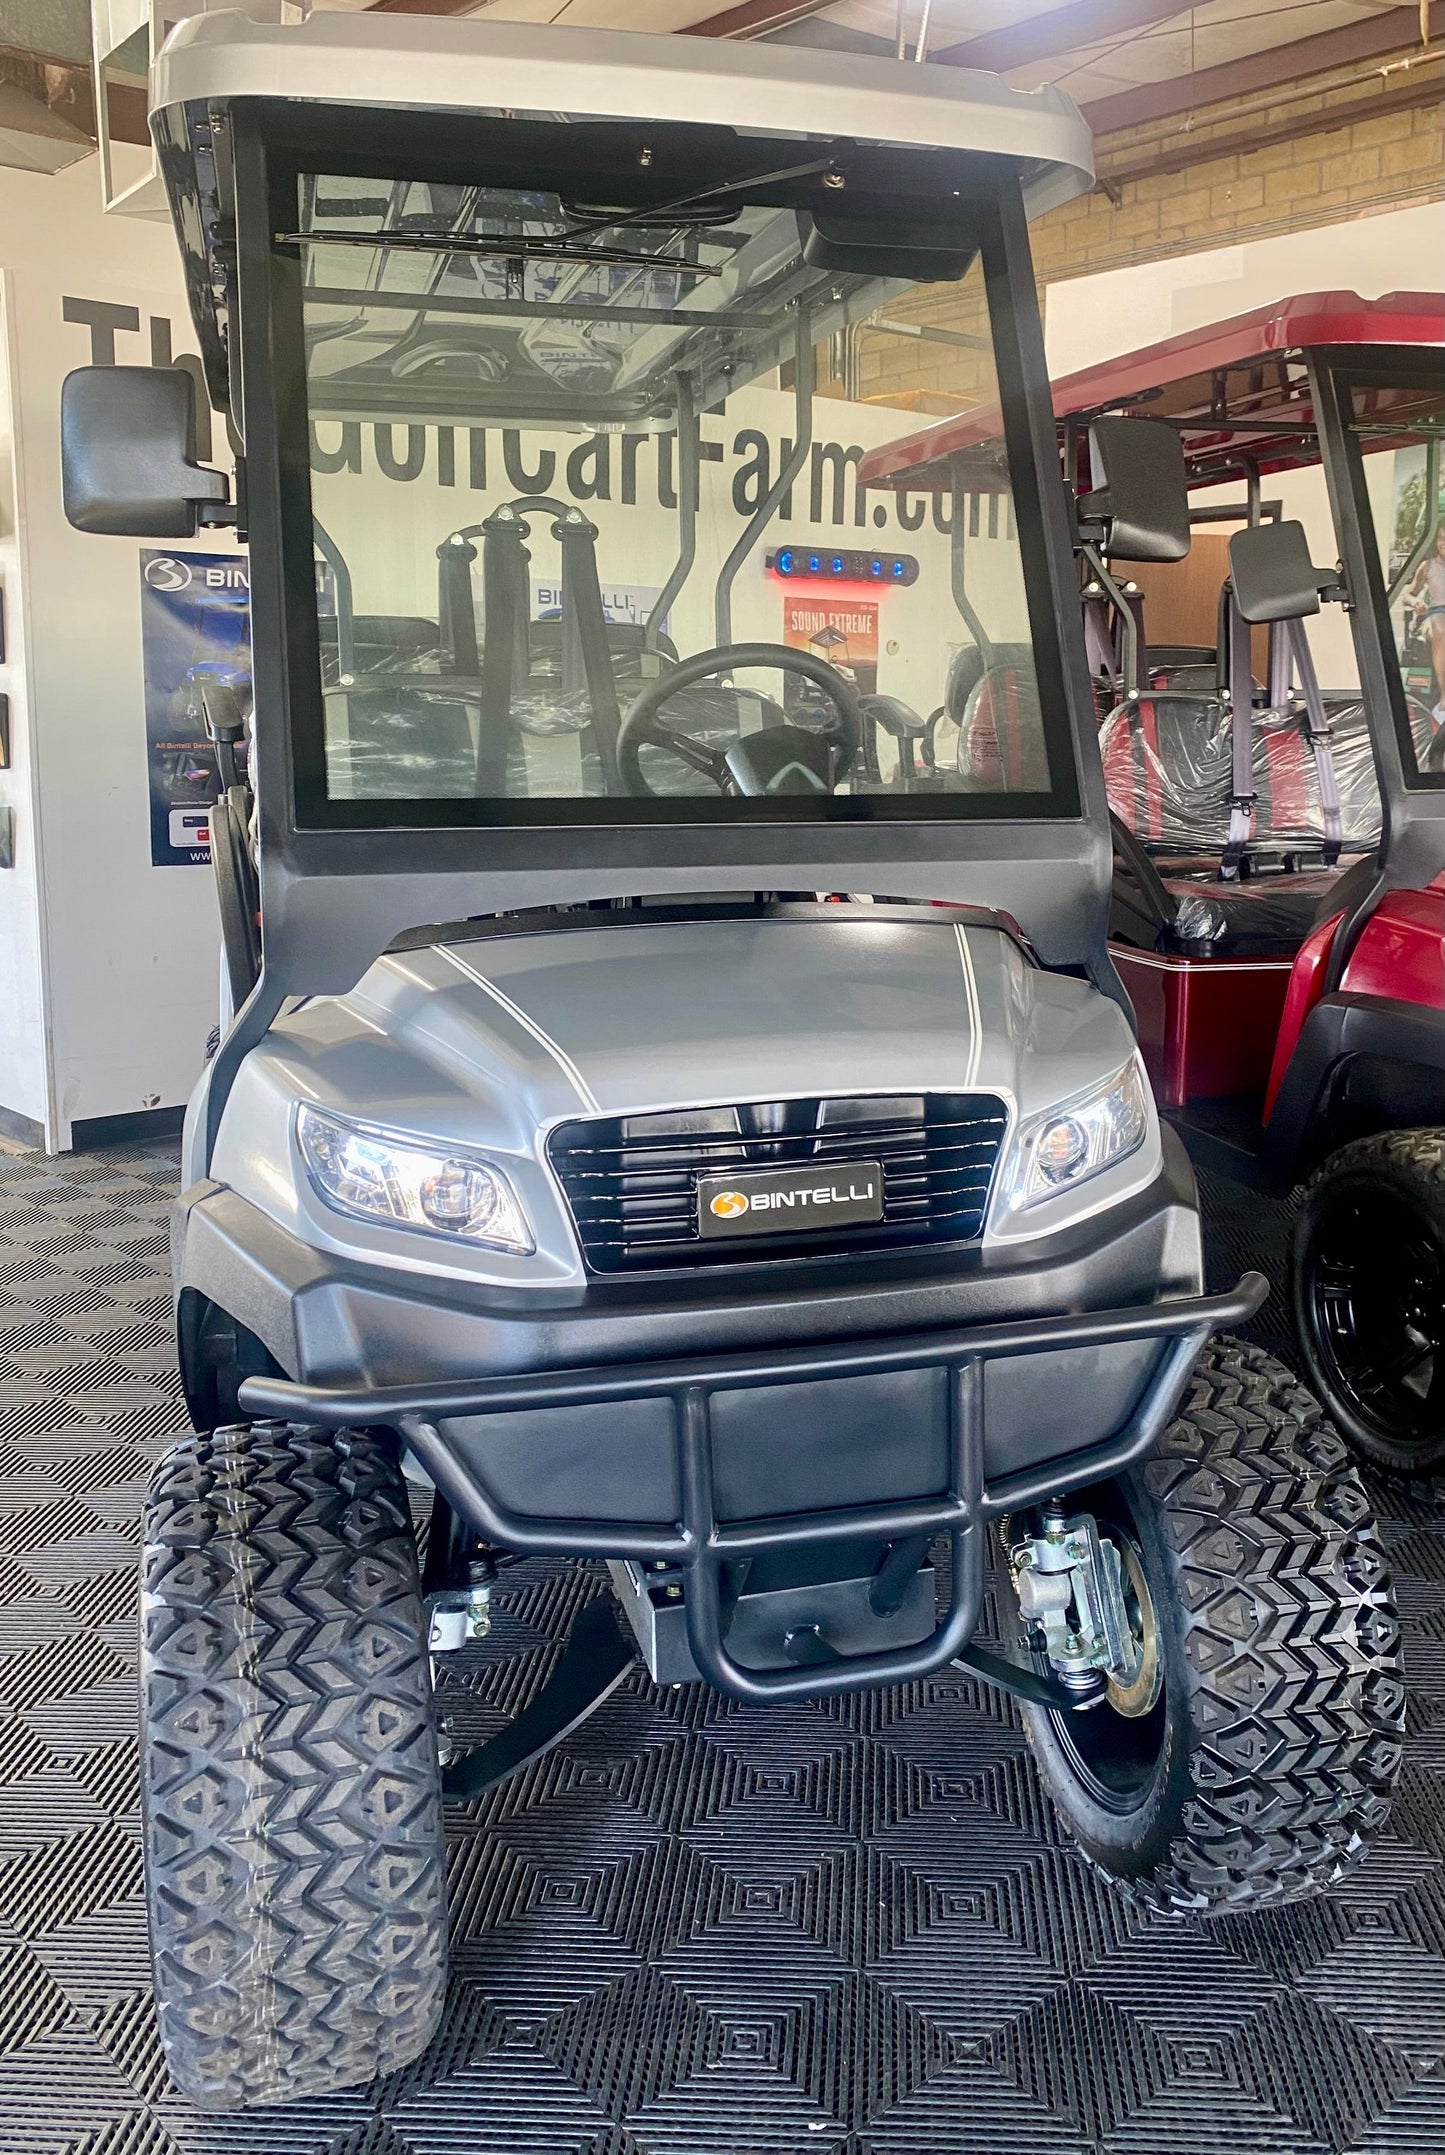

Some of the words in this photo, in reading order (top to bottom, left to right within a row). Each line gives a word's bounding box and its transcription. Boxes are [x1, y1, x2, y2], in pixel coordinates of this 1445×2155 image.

[62, 295, 246, 463] Th
[538, 588, 629, 609] BILLI
[791, 610, 826, 632] SOUND
[828, 612, 873, 634] EXTREME
[750, 1183, 873, 1211] BINTELLI
